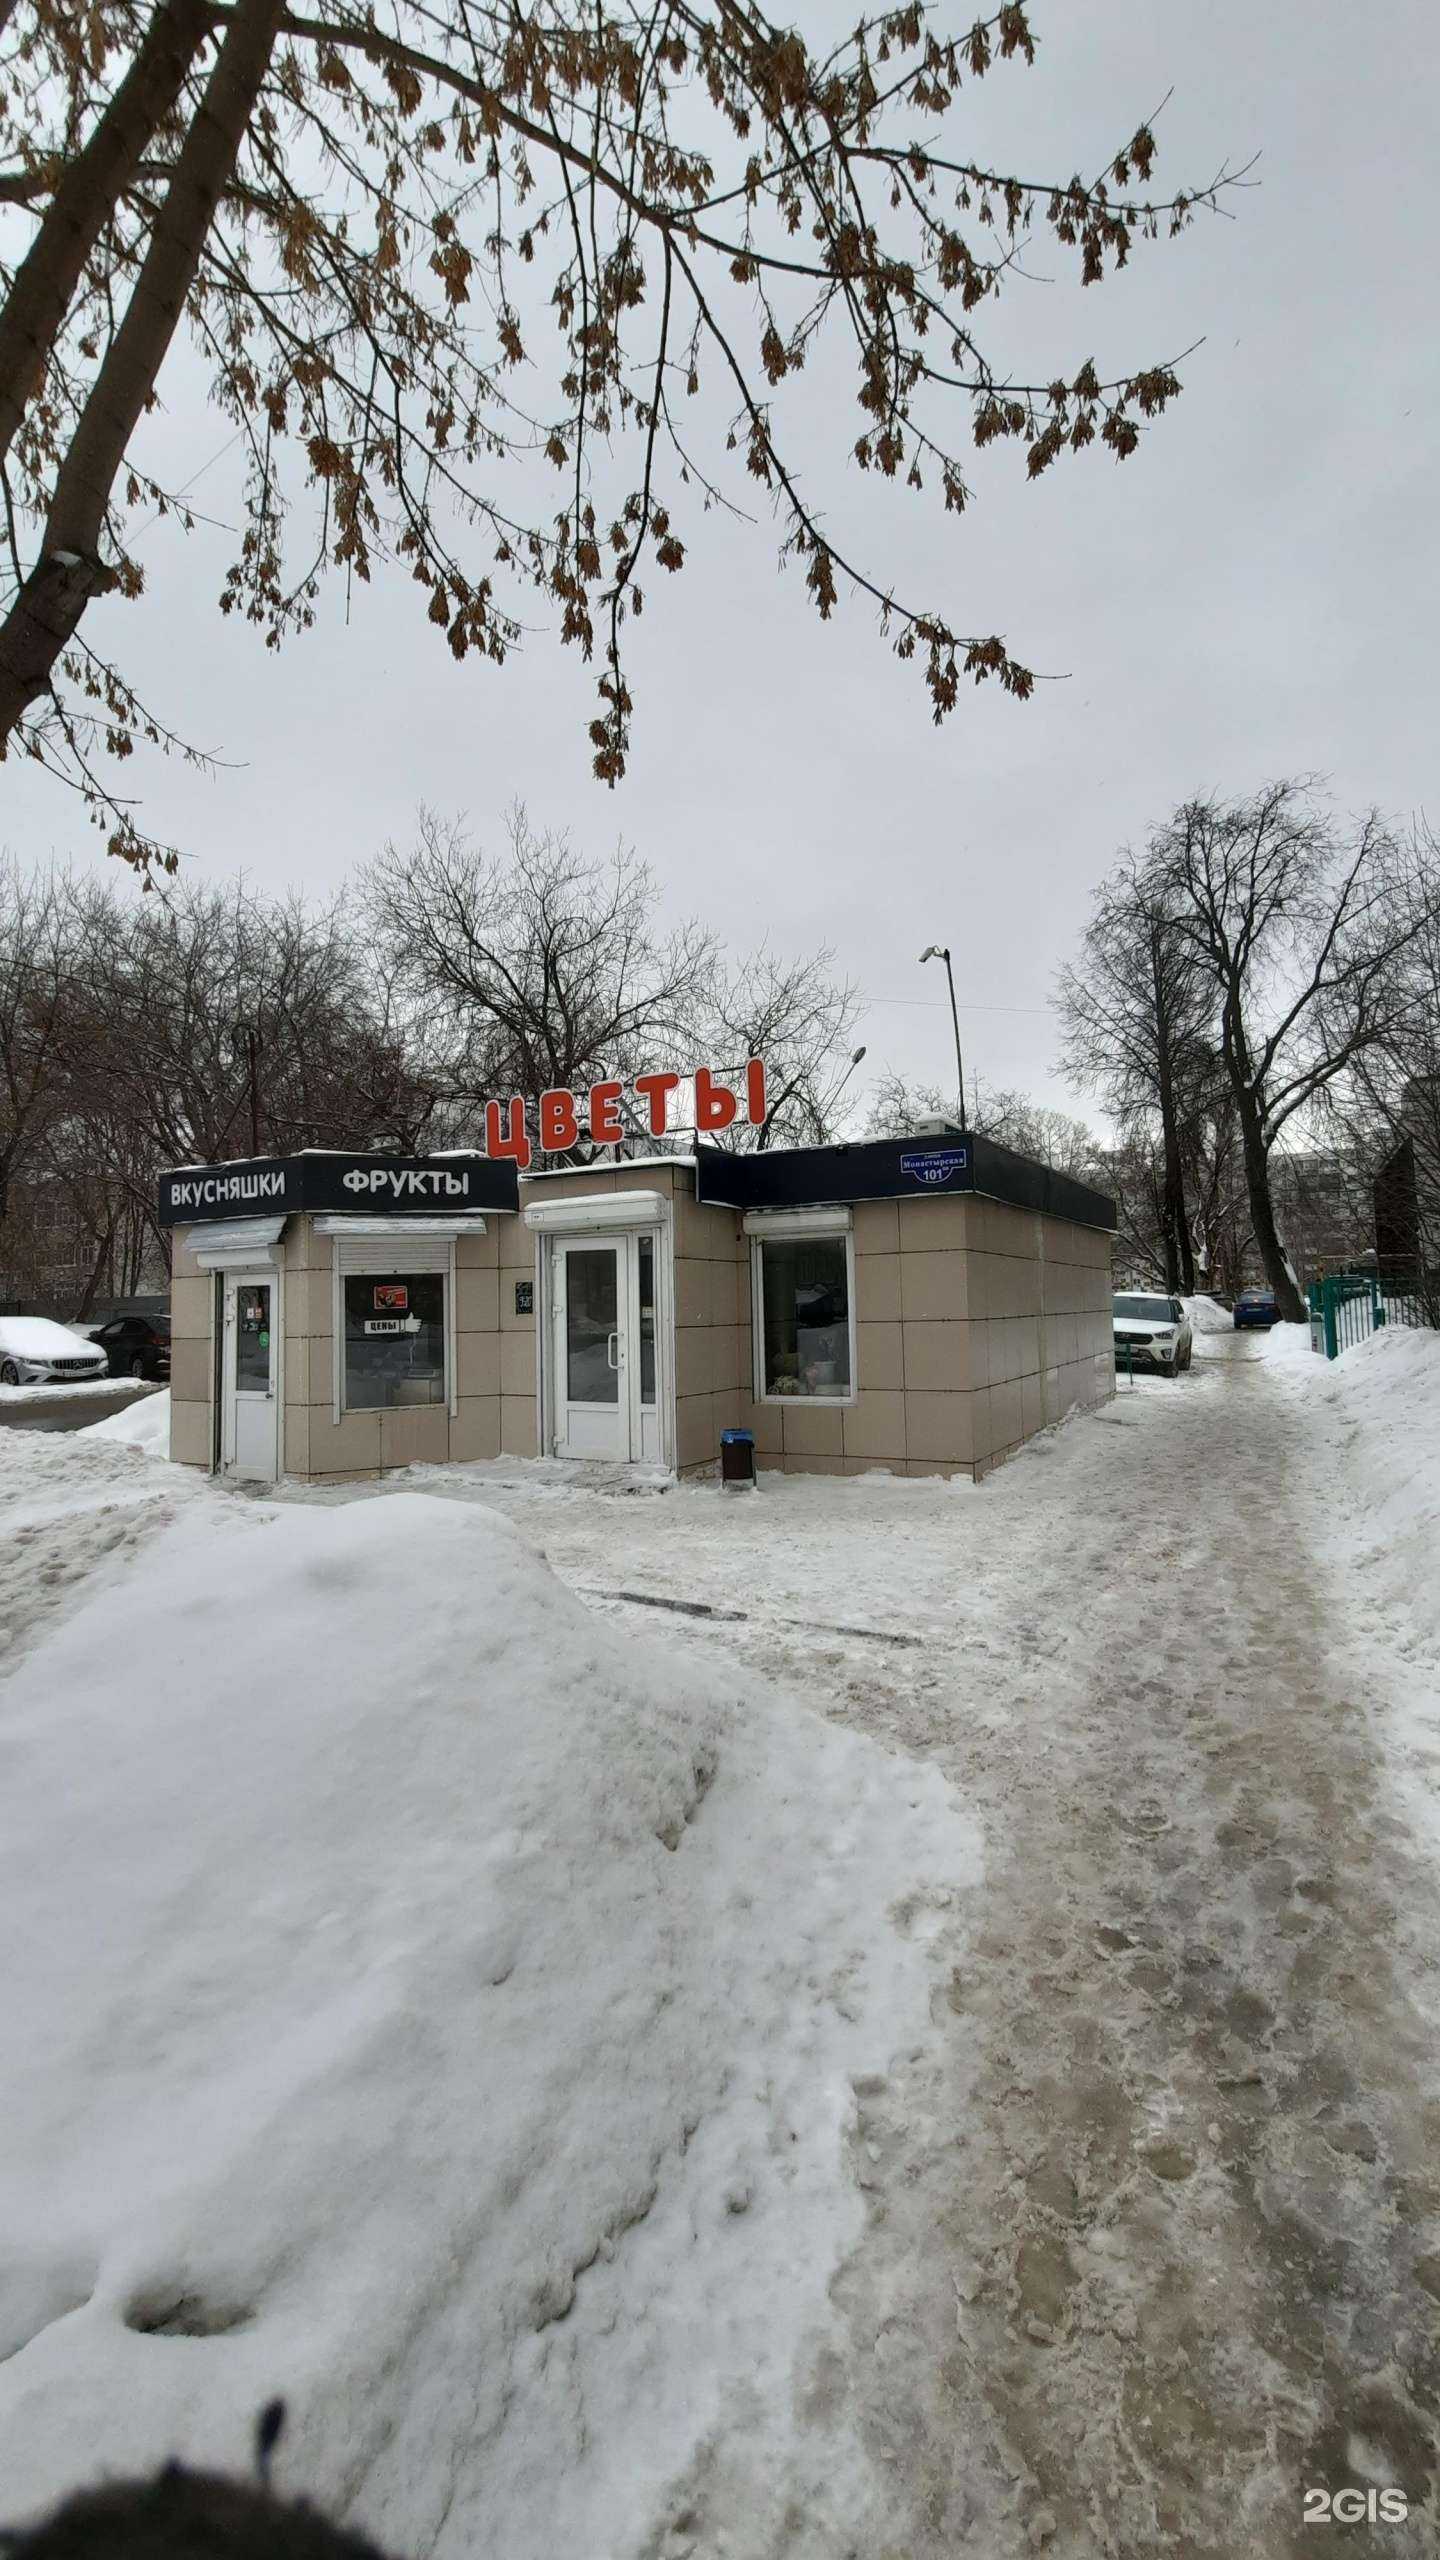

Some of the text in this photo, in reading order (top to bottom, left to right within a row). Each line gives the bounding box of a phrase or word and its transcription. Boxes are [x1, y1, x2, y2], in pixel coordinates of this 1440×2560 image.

[484, 1058, 767, 1169] ЦВЕТЫ
[171, 1171, 286, 1207] ВКУСНЯШКИ
[342, 1169, 469, 1198] ФРУКТЫ
[370, 1321, 397, 1331] ЦЕНЫ
